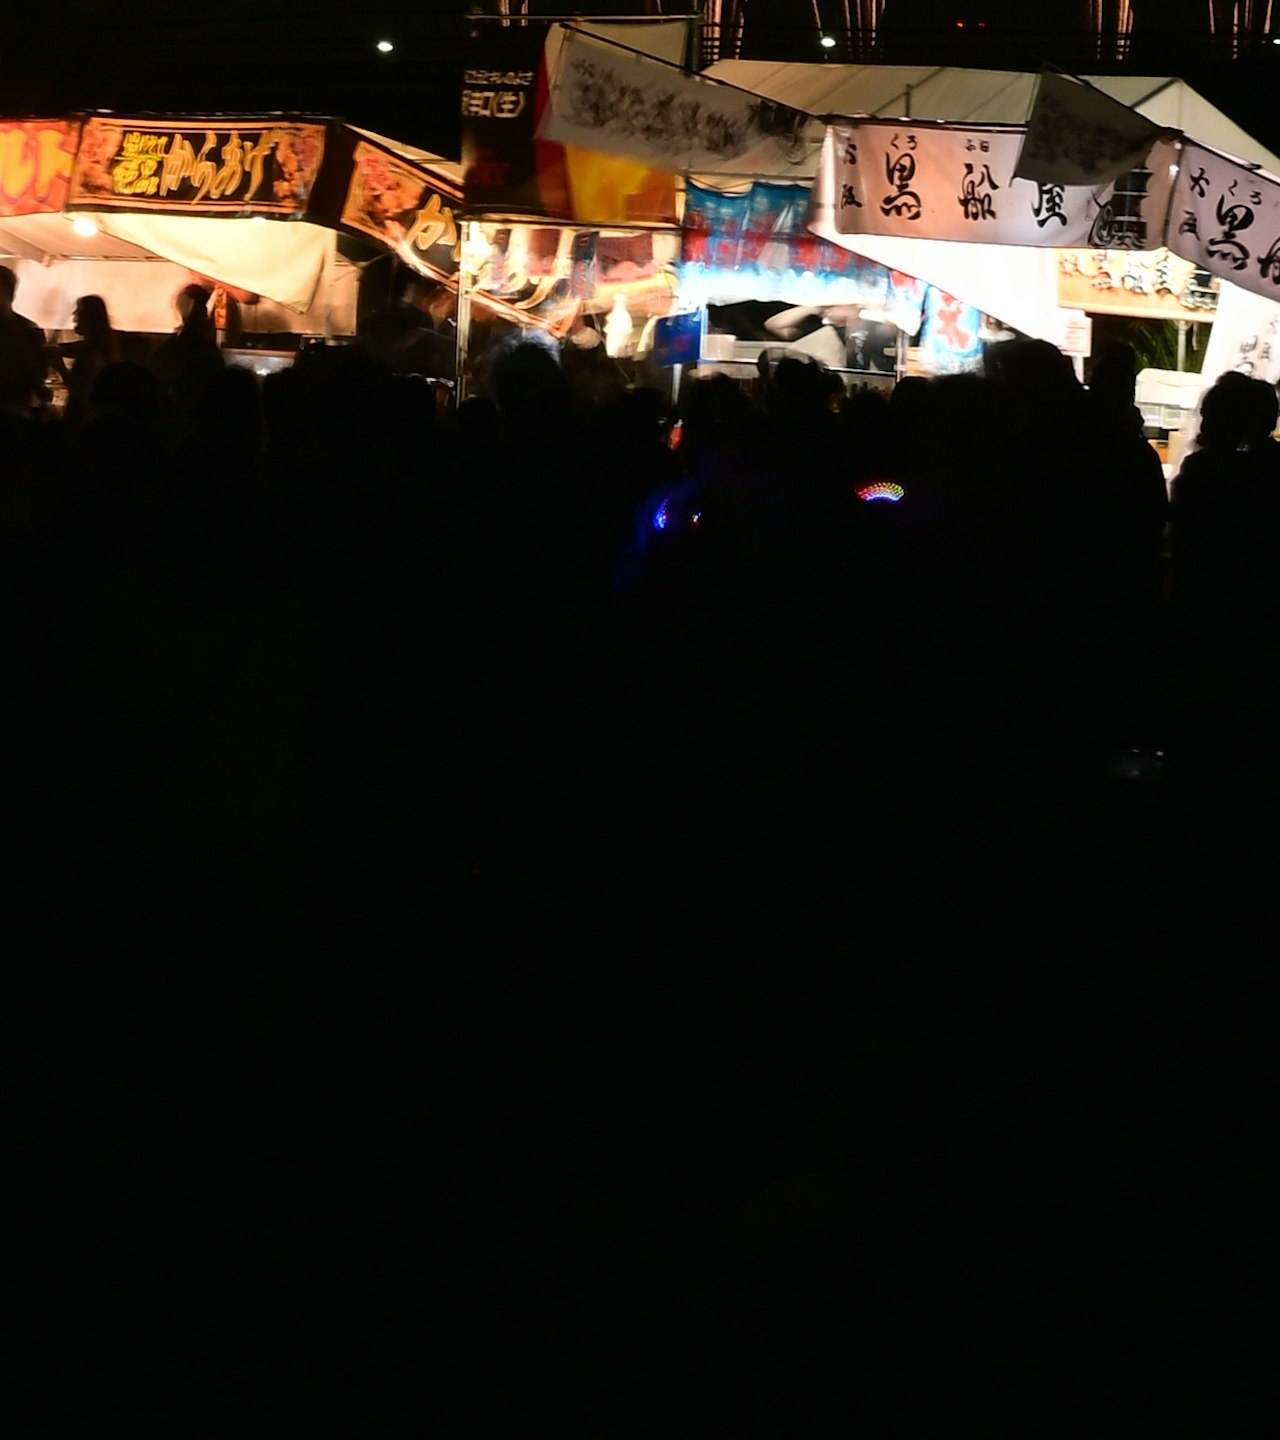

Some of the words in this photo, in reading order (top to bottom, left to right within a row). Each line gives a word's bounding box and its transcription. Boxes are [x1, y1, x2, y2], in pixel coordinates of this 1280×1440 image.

[159, 130, 282, 205] からあげ
[1227, 179, 1263, 206] くろ
